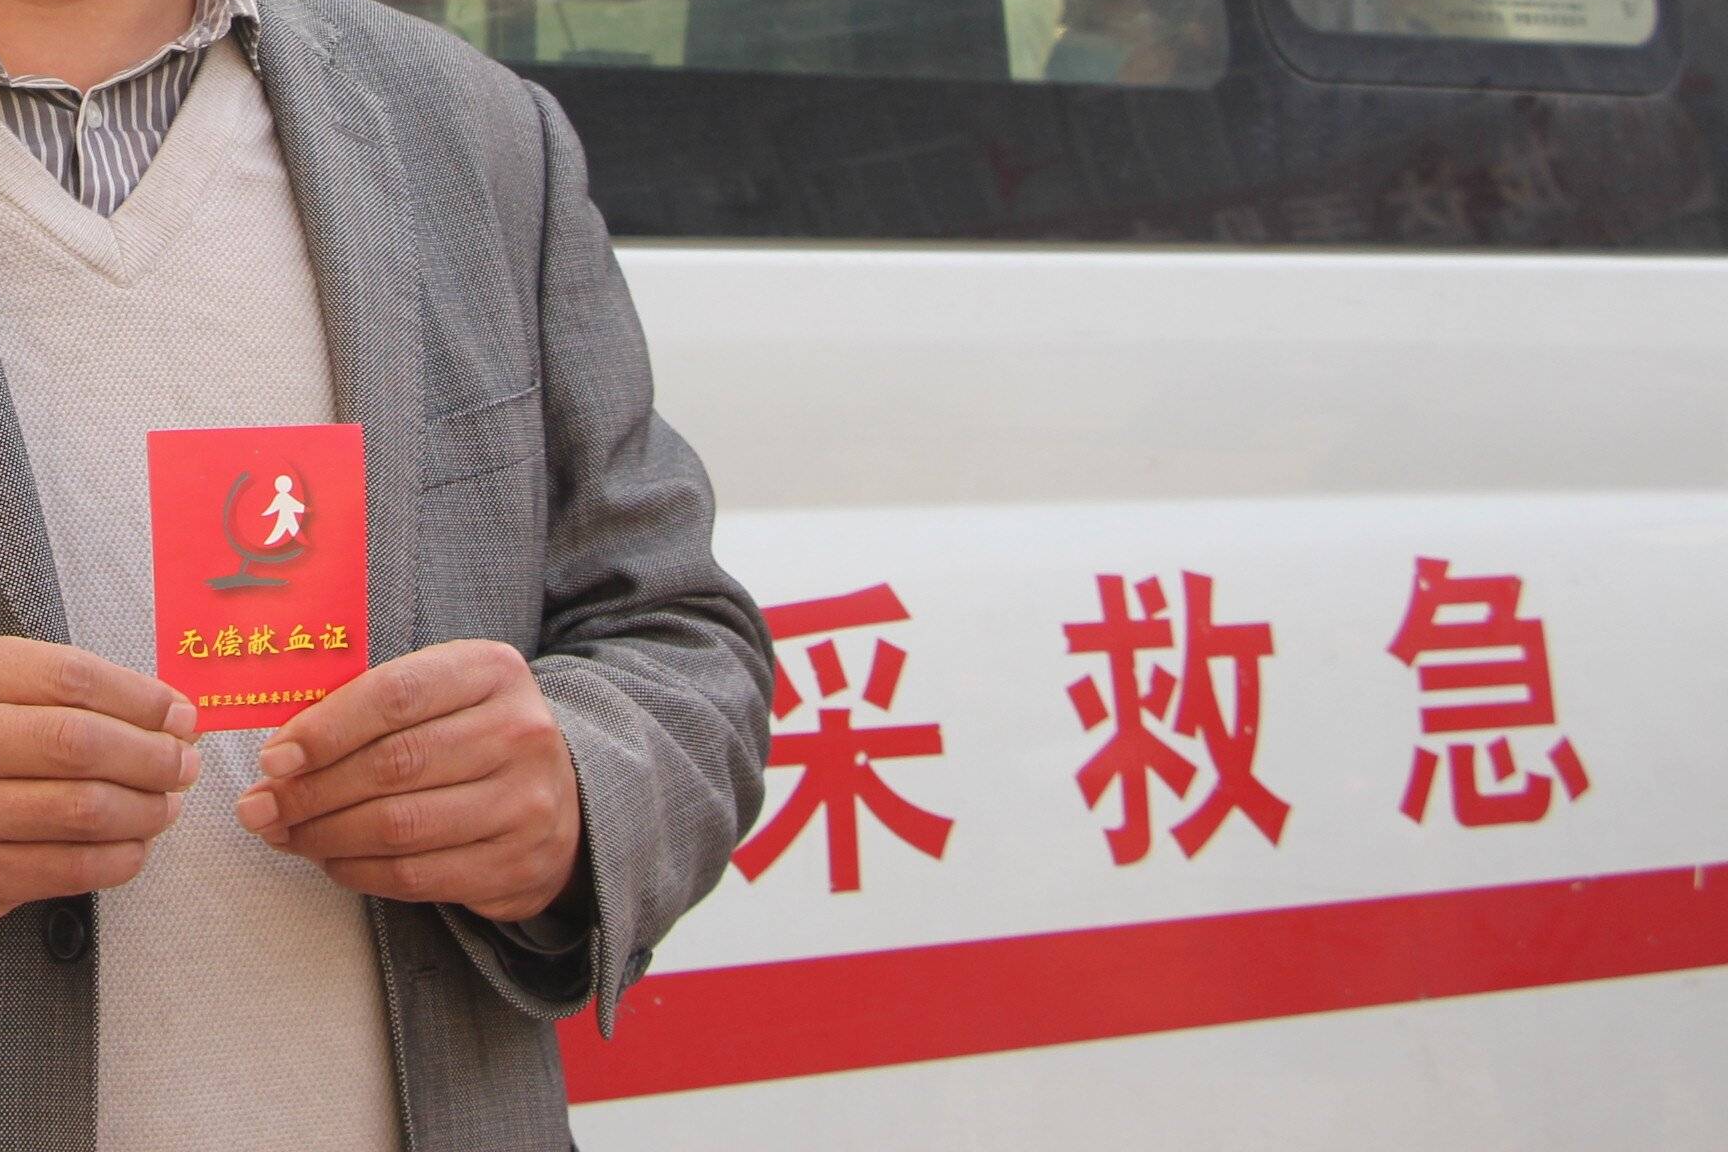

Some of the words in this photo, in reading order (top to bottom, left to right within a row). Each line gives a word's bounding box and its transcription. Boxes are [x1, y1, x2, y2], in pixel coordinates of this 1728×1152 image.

[176, 623, 349, 658] 无偿献血证
